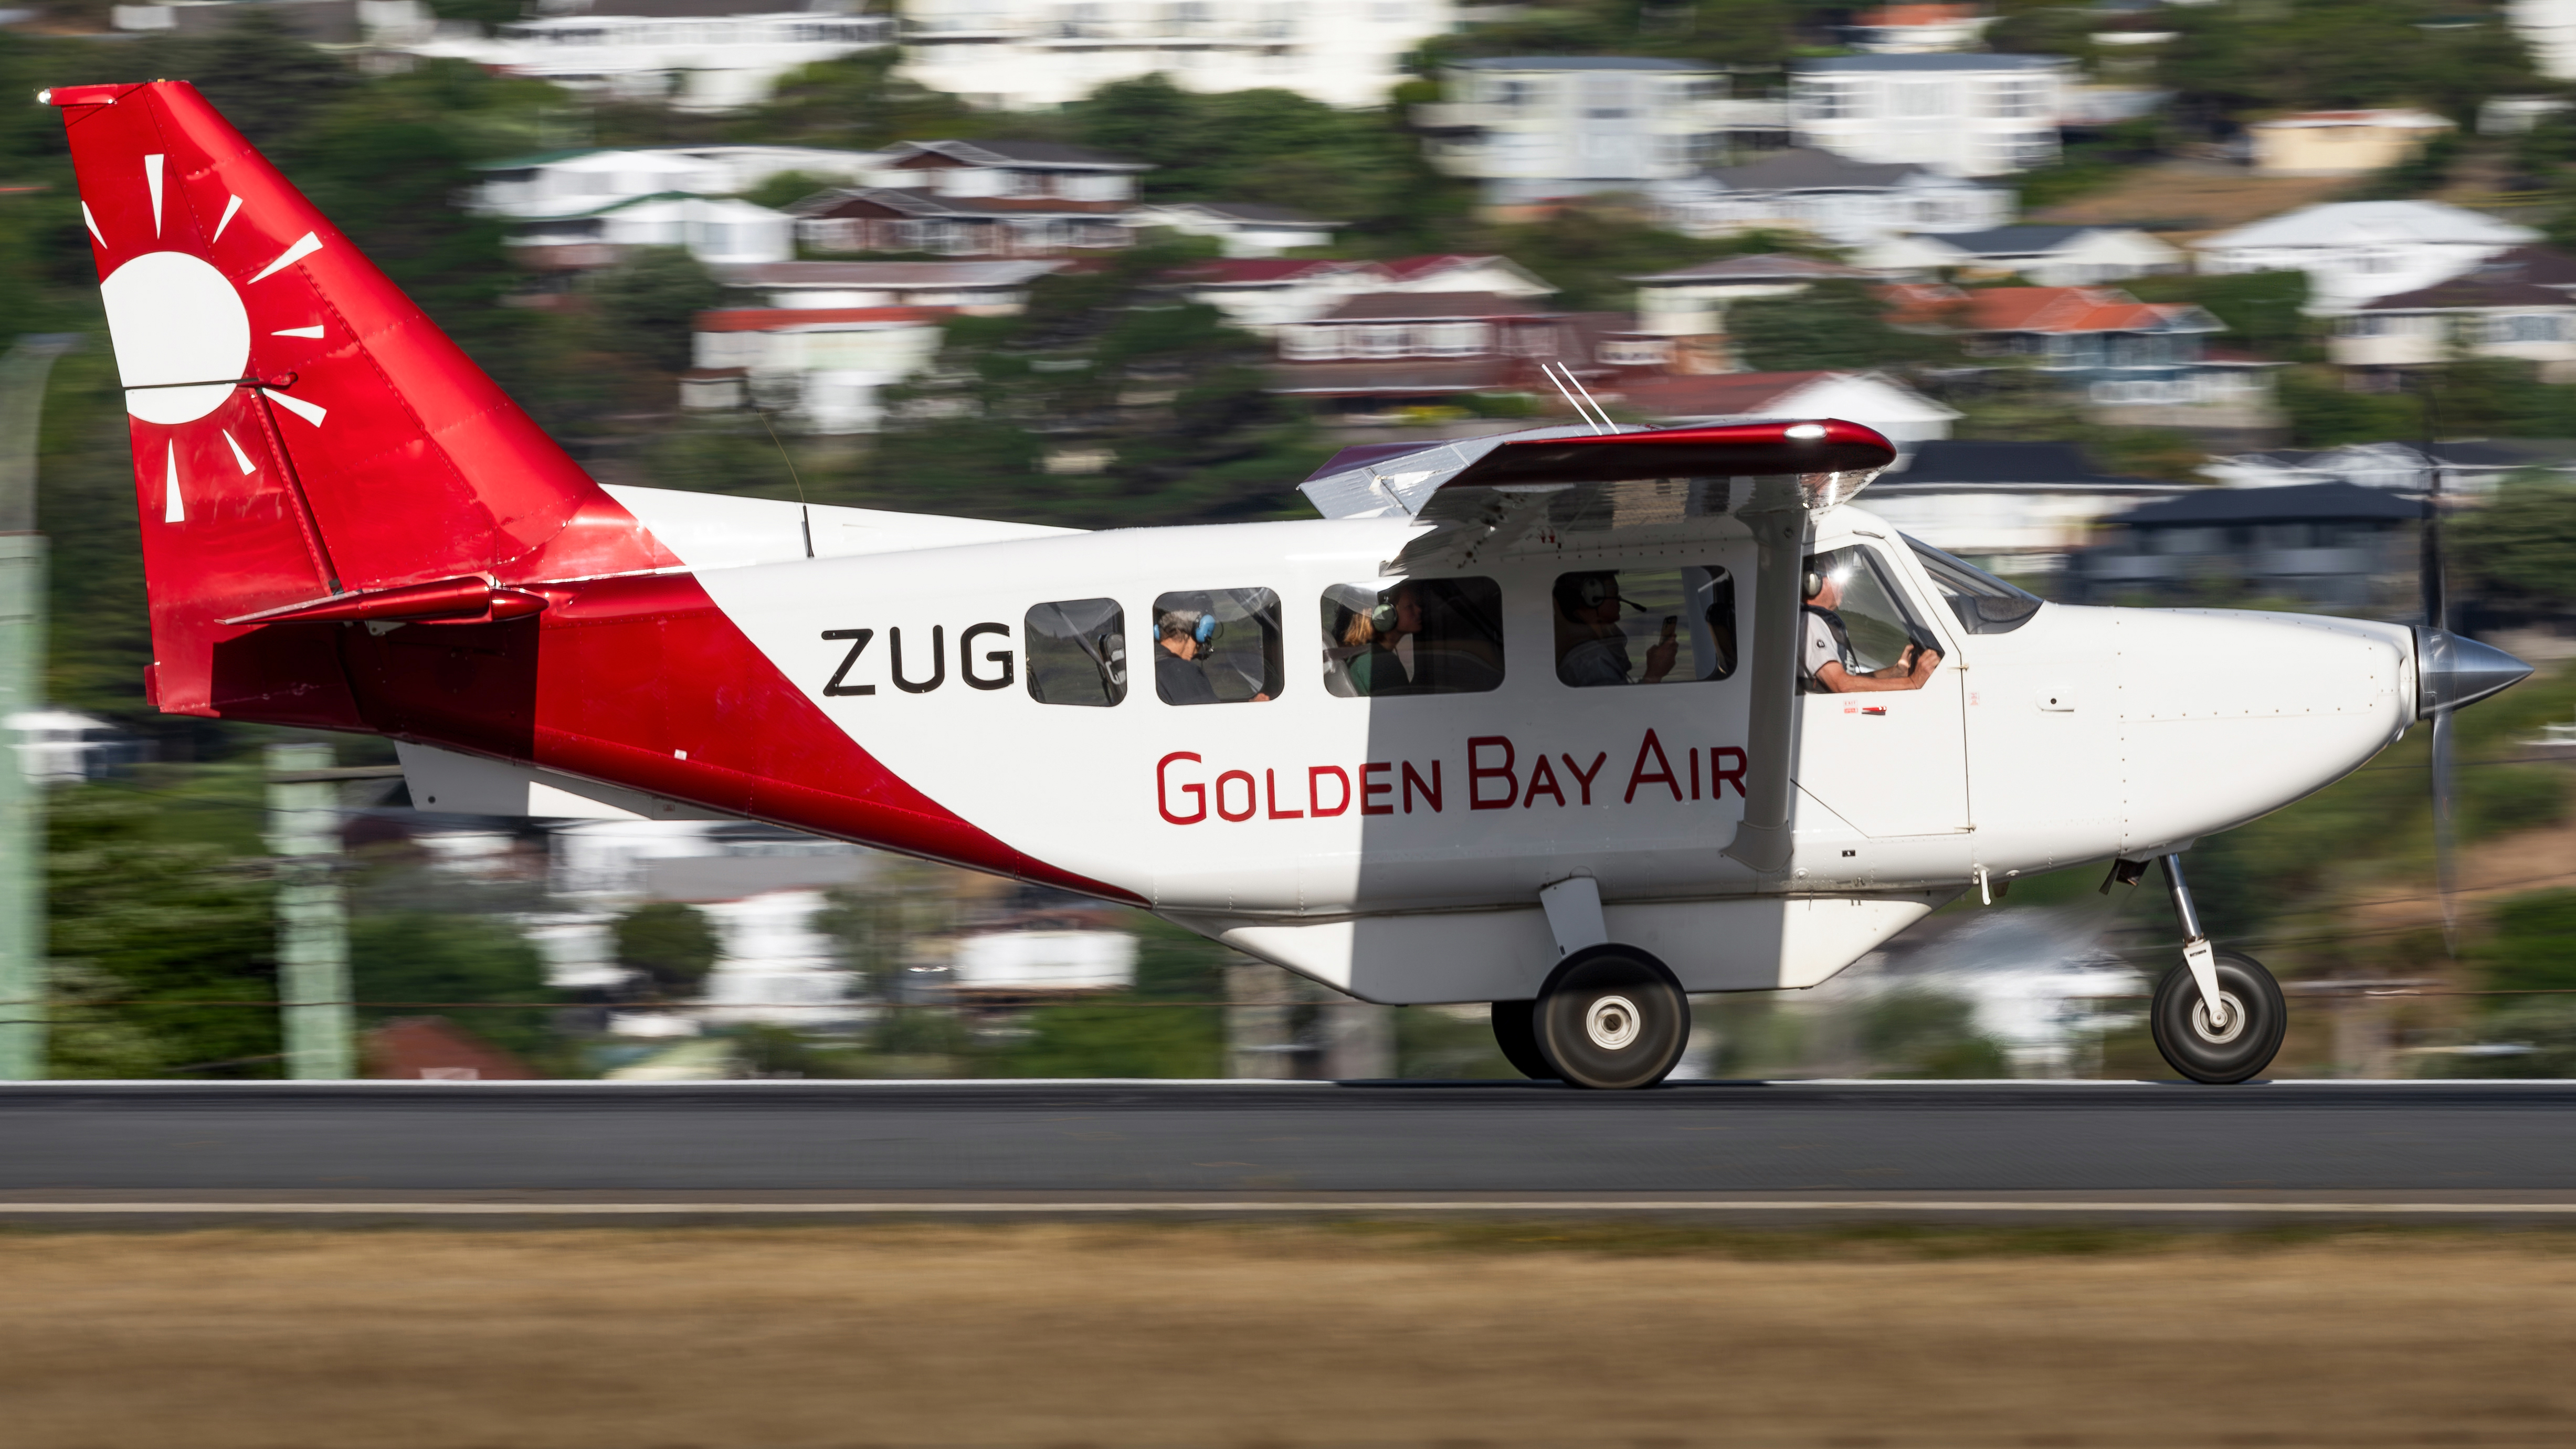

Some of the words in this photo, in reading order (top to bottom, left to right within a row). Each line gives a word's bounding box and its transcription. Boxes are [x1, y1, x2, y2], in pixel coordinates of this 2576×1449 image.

[821, 622, 1015, 697] ZUG
[1156, 750, 1442, 826] GOLDEN
[1468, 736, 1606, 810] BAY
[1624, 728, 1747, 803] AIR
